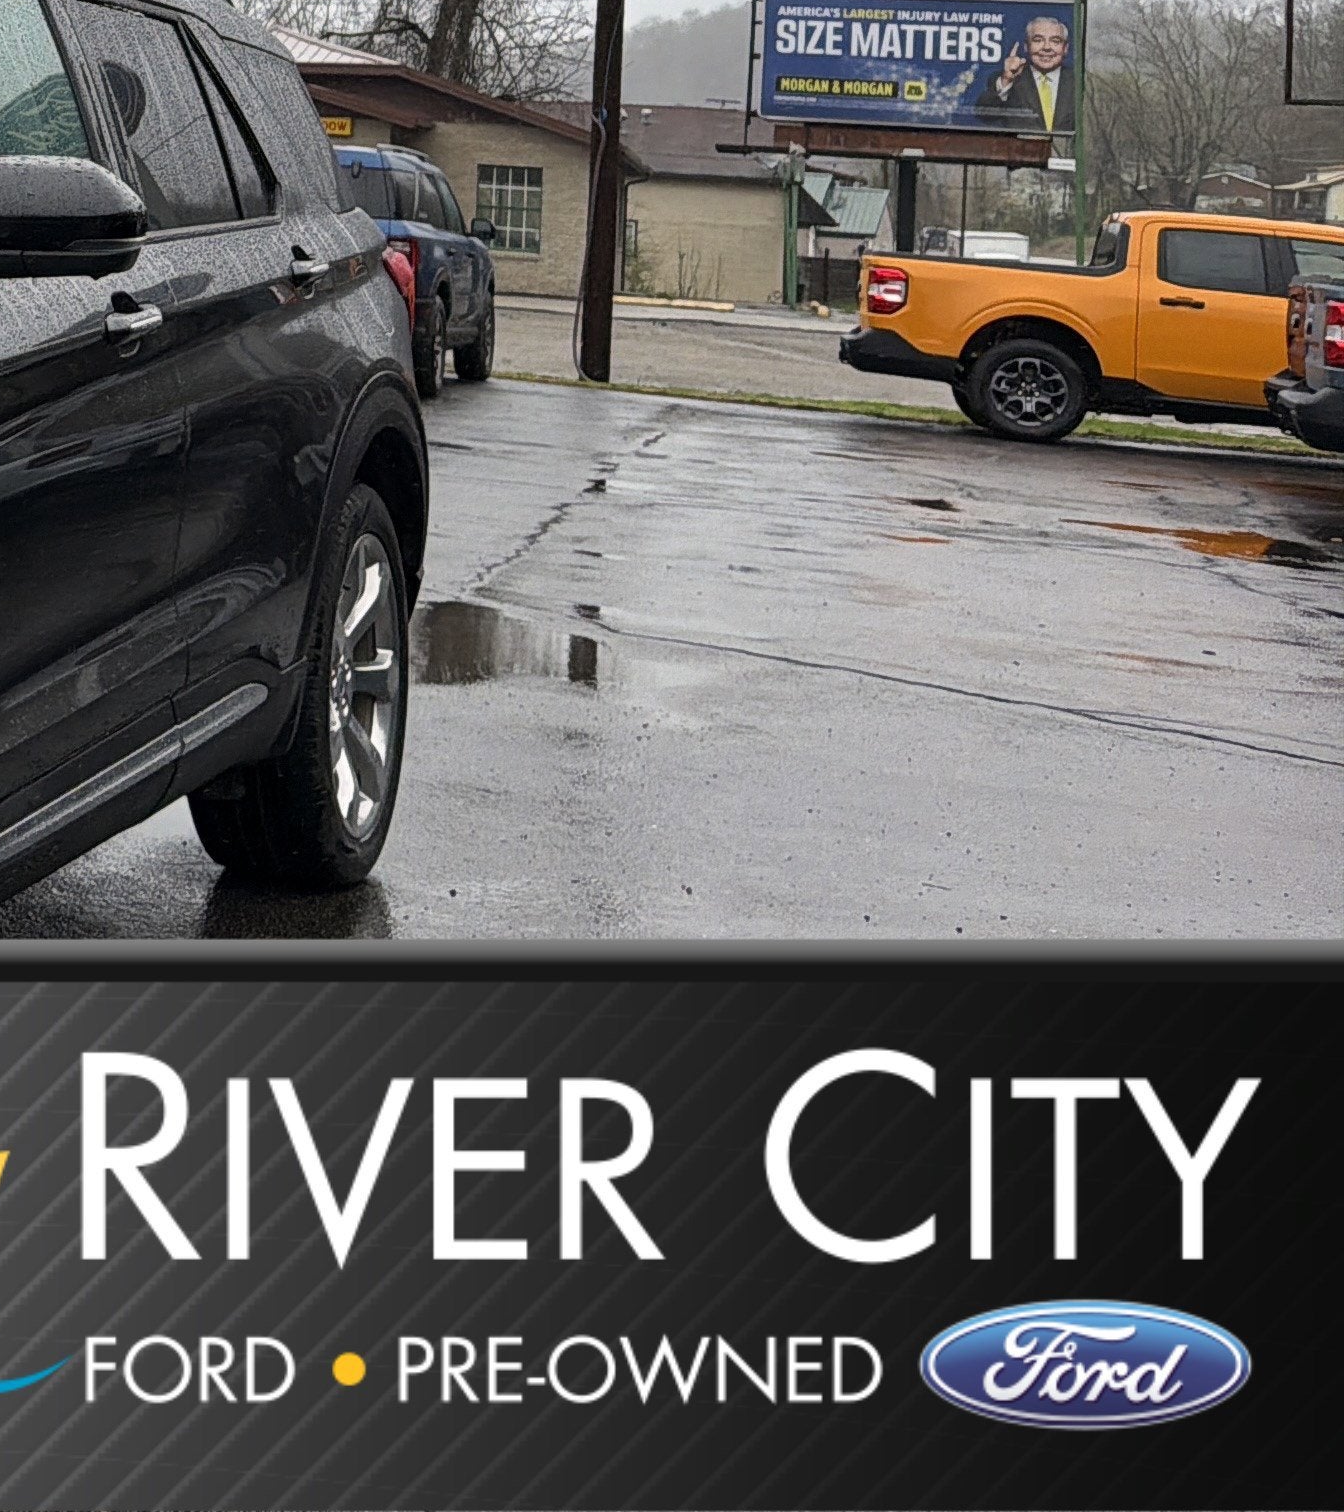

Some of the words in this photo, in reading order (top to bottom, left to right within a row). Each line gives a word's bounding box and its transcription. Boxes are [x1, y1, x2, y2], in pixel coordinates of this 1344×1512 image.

[777, 5, 841, 19] AMERICA'S
[842, 8, 895, 21] LARGEST
[897, 10, 942, 22] INJURY
[943, 12, 971, 23] LAW
[972, 13, 1004, 25] FIRM
[776, 18, 845, 56] SIZE
[850, 21, 1003, 63] MATTERS
[780, 77, 830, 93] MORGAN
[832, 80, 841, 94] &
[843, 81, 894, 98] MORGAN
